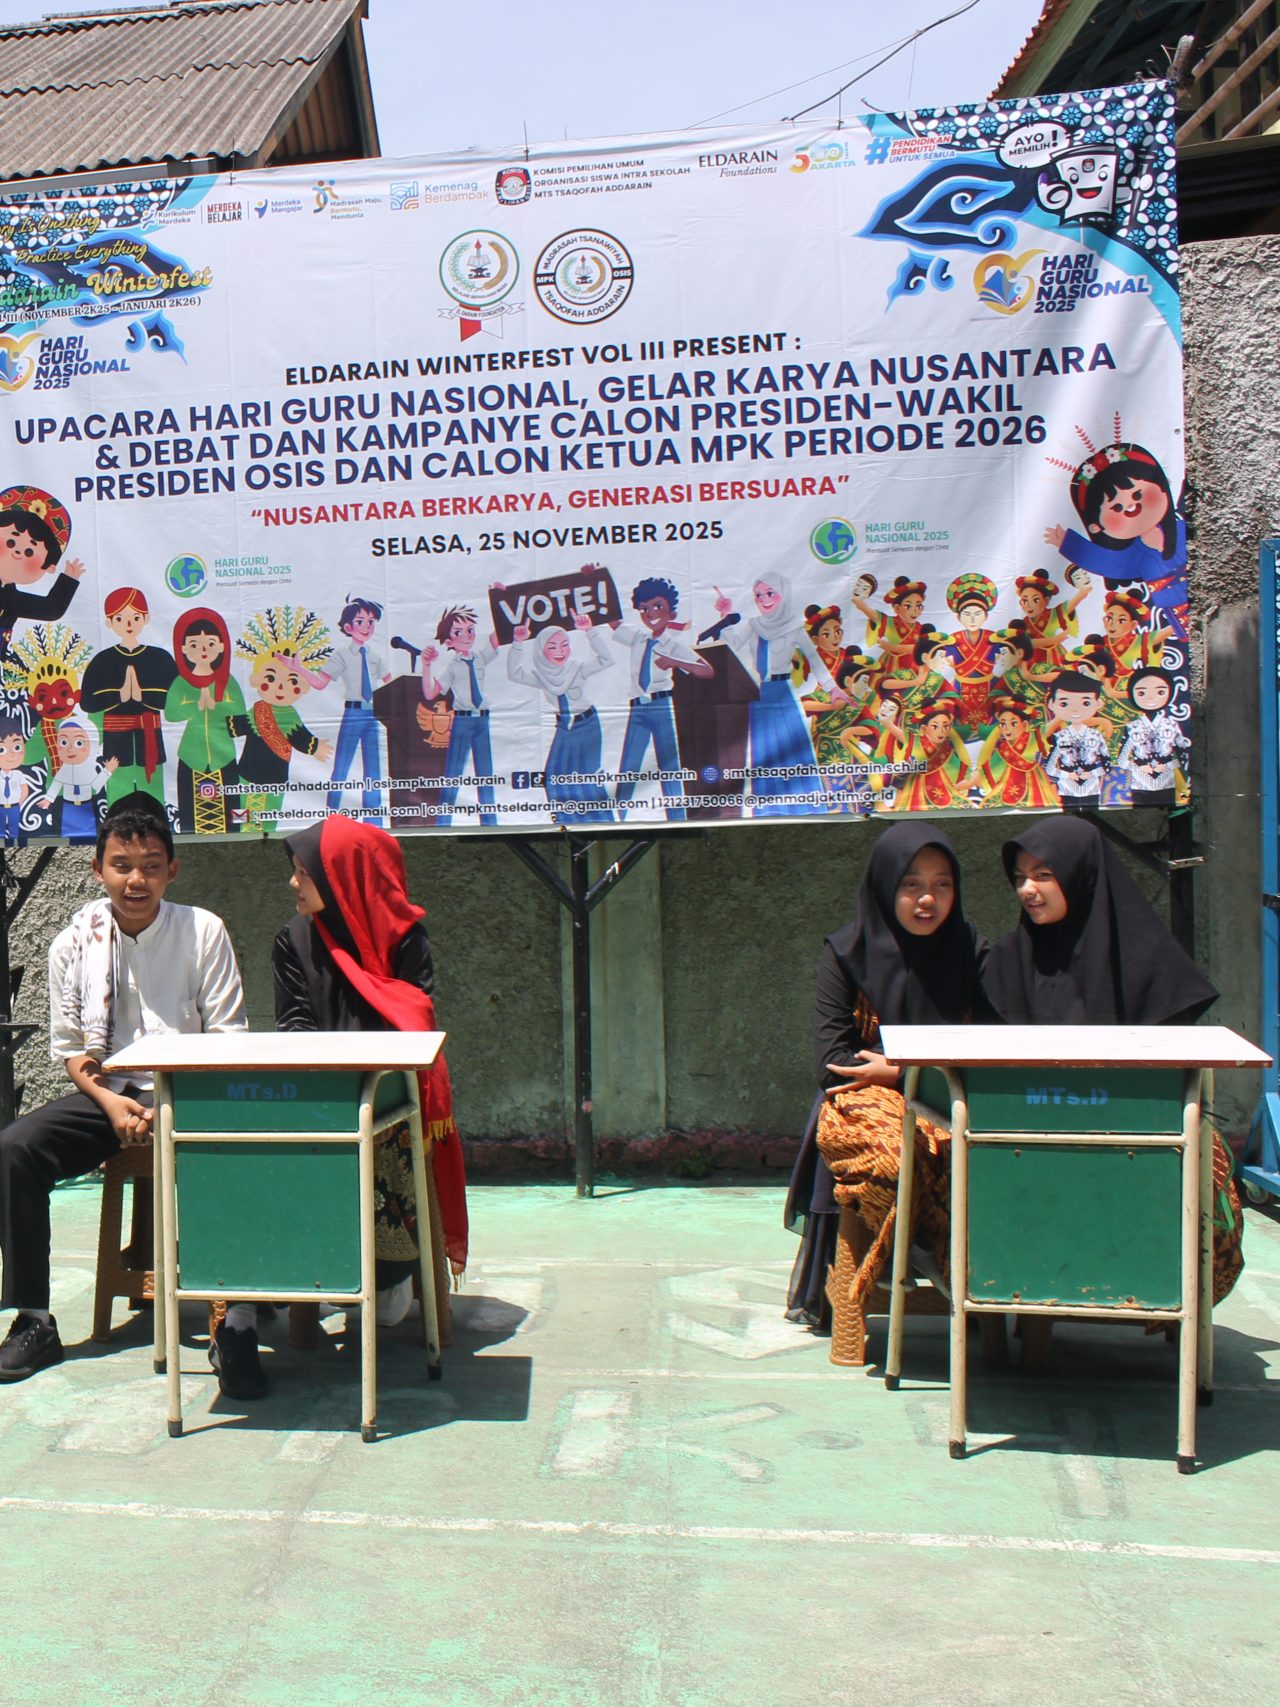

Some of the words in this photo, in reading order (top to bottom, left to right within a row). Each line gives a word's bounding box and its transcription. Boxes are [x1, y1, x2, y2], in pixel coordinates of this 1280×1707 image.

[1014, 133, 1044, 147] AYO
[698, 149, 778, 168] ELDARAIN
[889, 154, 921, 163] UNTUK
[923, 151, 955, 160] SEMUA
[891, 145, 935, 156] BERMUTU
[534, 167, 565, 176] KOMISI
[567, 162, 614, 173] PEMILIHAN
[616, 160, 644, 169] UMUM
[719, 164, 778, 178] Foundations
[534, 176, 588, 187] ORGANISASI
[590, 173, 619, 182] SISWA
[621, 171, 647, 179] INTRA
[649, 167, 690, 177] SEKOLAH
[425, 181, 478, 193] Kemenag
[534, 190, 553, 198] MTS
[555, 186, 603, 197] TSAQOFAH
[605, 182, 652, 192] ADDARAIN
[271, 198, 301, 207] Merdeka
[425, 190, 489, 204] Berdampak
[158, 209, 196, 217] Kurikulum
[207, 201, 242, 213] MERDEKA
[271, 205, 303, 214] Mengajar
[19, 217, 35, 233] Is
[158, 217, 191, 225] Merdeka
[207, 212, 242, 224] BELAJAR
[16, 248, 70, 265] Practice
[74, 240, 149, 264] Everything
[544, 237, 578, 270] MADRASAH
[578, 235, 624, 264] TSANAWIYAH
[1041, 253, 1094, 272] HARI
[86, 266, 213, 295] Winterfest
[536, 275, 555, 284] MPK
[613, 269, 632, 278] OSIS
[1040, 268, 1098, 286] GURU
[1036, 278, 1150, 301] NASIONAL
[82, 305, 110, 315] 2K25
[119, 300, 167, 312] JANUARI
[544, 290, 585, 318] TSAQOFAH
[586, 284, 626, 317] ADDARAIN
[1034, 300, 1075, 313] 2025
[40, 335, 83, 353] HARI
[38, 349, 89, 366] GURU
[285, 360, 409, 386] ELDARAIN
[417, 348, 574, 379] WINTERFEST
[582, 344, 634, 367] VOL
[640, 341, 666, 361] III
[673, 332, 787, 358] PRESENT
[35, 358, 130, 380] NASIONAL
[33, 377, 70, 391] 2025
[15, 407, 176, 444] UPACARA
[190, 400, 272, 432] HARI
[282, 393, 380, 423] GURU
[391, 380, 587, 419] NASIONAL,
[597, 370, 716, 403] GELAR
[727, 361, 859, 396] KARYA
[871, 342, 1116, 386] NUSANTARA
[95, 444, 120, 470] &
[129, 434, 239, 467] DEBAT
[262, 430, 326, 459] DAN
[336, 413, 541, 453] KAMPANYE
[551, 405, 681, 437] CALON
[691, 384, 1023, 430] PRESIDEN-WAKIL
[75, 462, 236, 503] PRESIDEN
[244, 456, 322, 489] OSIS
[335, 456, 412, 485] DAN
[422, 446, 550, 479] CALON
[560, 436, 682, 472] KETUA
[691, 431, 774, 463] MPK
[785, 421, 945, 458] PERIODE
[954, 415, 1047, 448] 2026
[422, 492, 562, 520] BERKARYA,
[568, 484, 693, 509] GENERASI
[865, 523, 891, 533] HARI
[894, 521, 925, 531] GURU
[371, 533, 472, 558] SELASA,
[478, 532, 506, 551] 25
[513, 522, 658, 551] NOVEMBER
[665, 520, 724, 544] 2025
[865, 532, 920, 544] NASIONAL
[923, 531, 949, 541] 2025
[214, 558, 238, 568] HARI
[240, 556, 269, 566] GURU
[215, 567, 265, 578] NASIONAL
[267, 565, 292, 575] 2025
[499, 581, 609, 625] VOTE!
[227, 1083, 297, 1100] MTs.D
[1026, 1087, 1108, 1105] MTs.D
